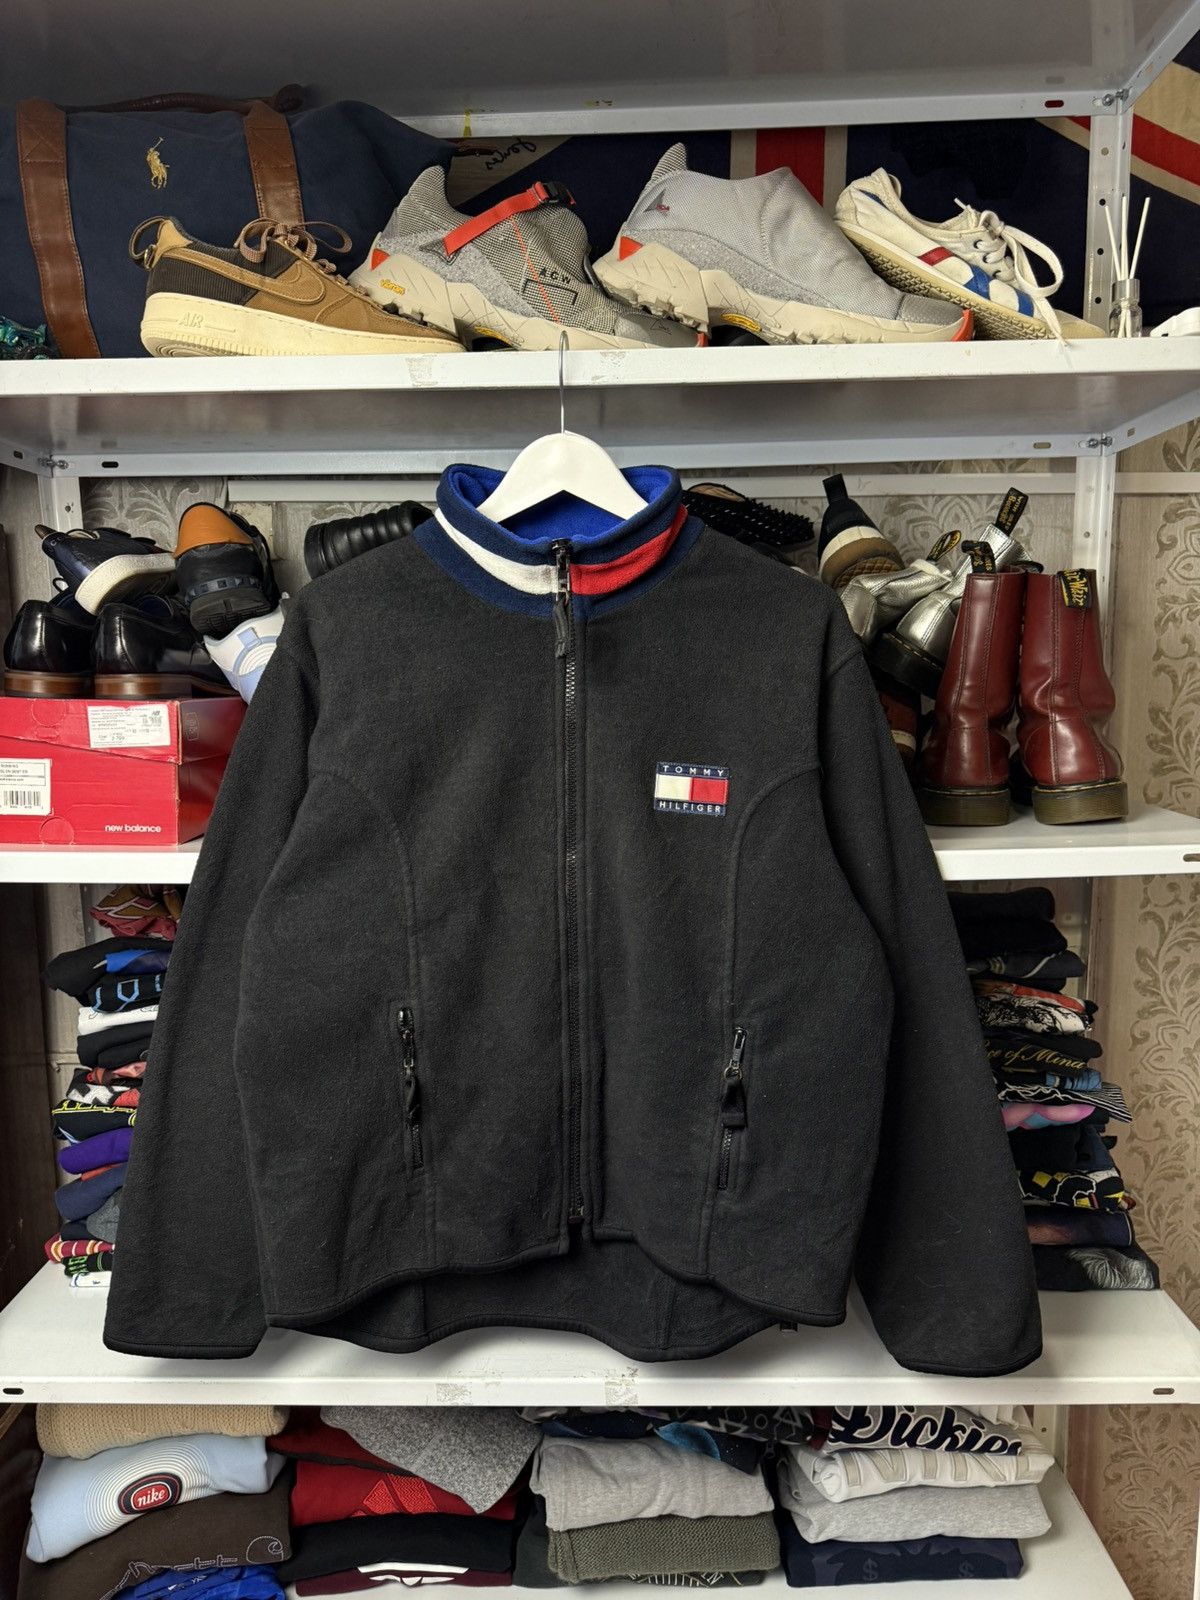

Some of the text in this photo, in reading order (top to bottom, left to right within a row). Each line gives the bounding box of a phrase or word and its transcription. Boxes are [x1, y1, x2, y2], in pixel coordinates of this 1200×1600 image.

[179, 312, 204, 329] AIR
[662, 765, 725, 777] TOMMY
[659, 800, 721, 813] HILFIGER
[104, 823, 162, 833] new balance
[137, 1487, 166, 1508] nike
